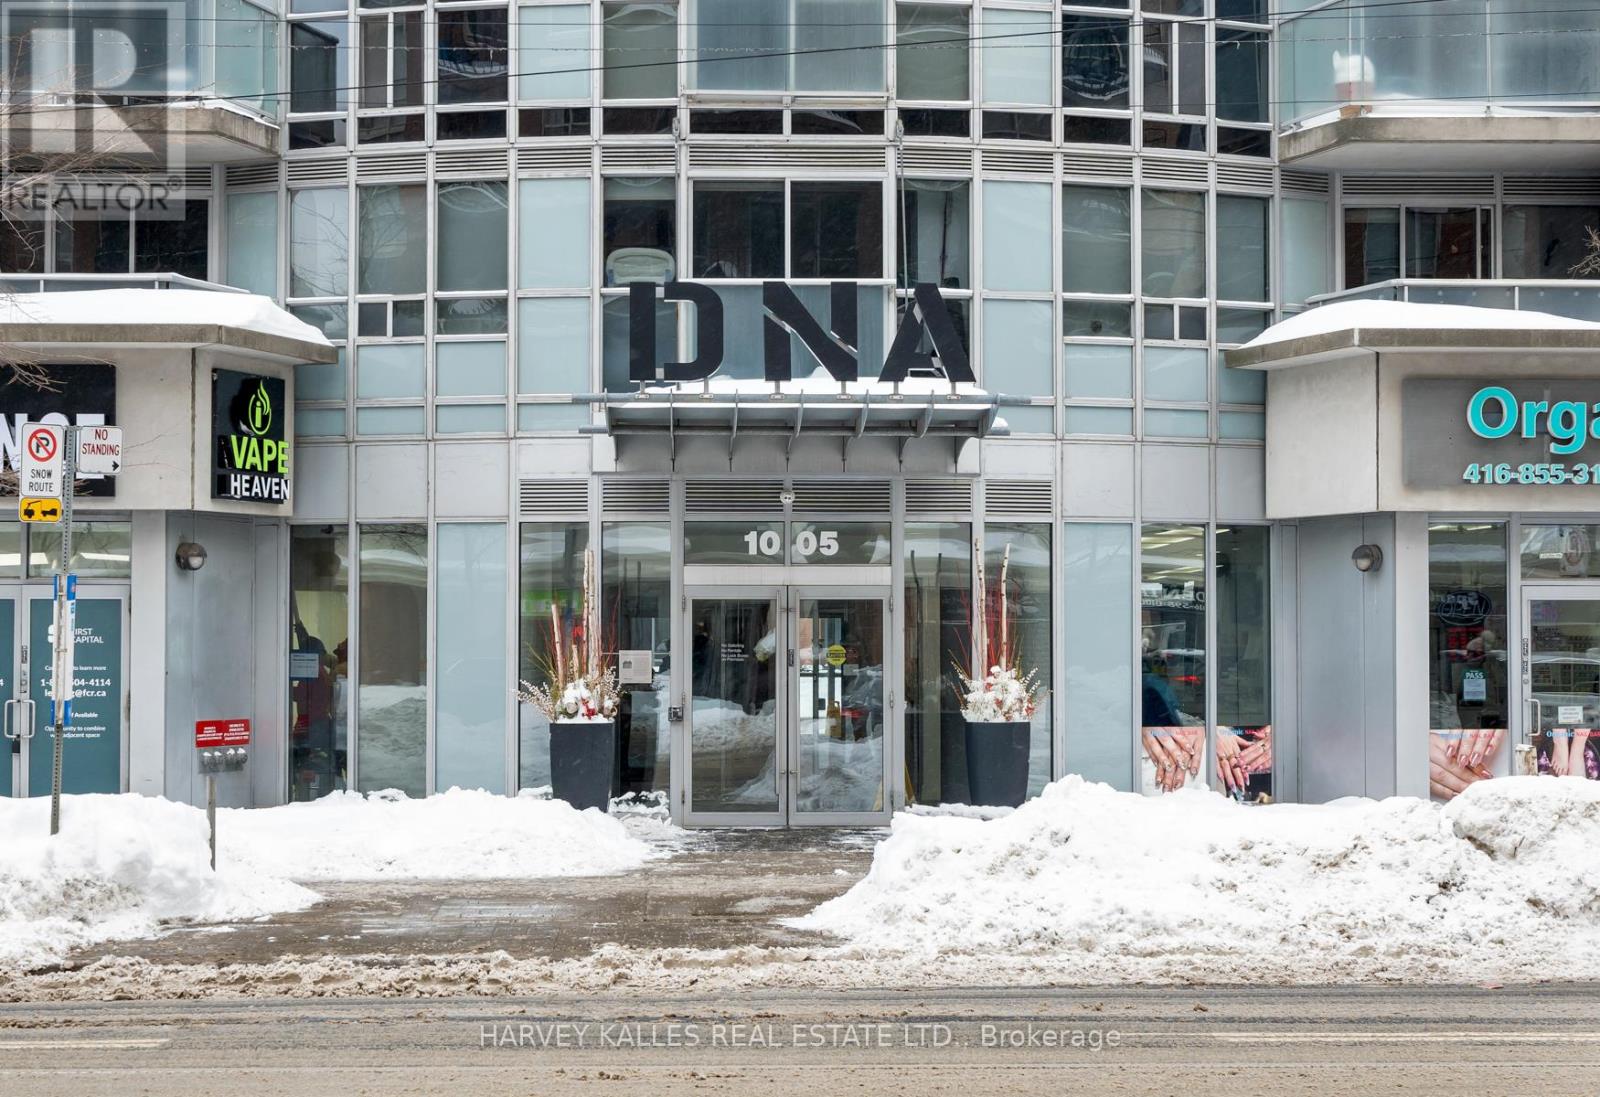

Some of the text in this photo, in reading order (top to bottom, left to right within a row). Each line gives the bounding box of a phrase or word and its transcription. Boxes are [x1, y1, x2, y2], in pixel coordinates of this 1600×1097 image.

[629, 281, 977, 383] DNA
[94, 428, 108, 441] NO
[82, 443, 120, 456] STANDING
[231, 435, 289, 474] VAPE
[30, 468, 53, 479] SNOW
[28, 482, 54, 493] ROUTE
[230, 474, 290, 500] HEAVEN
